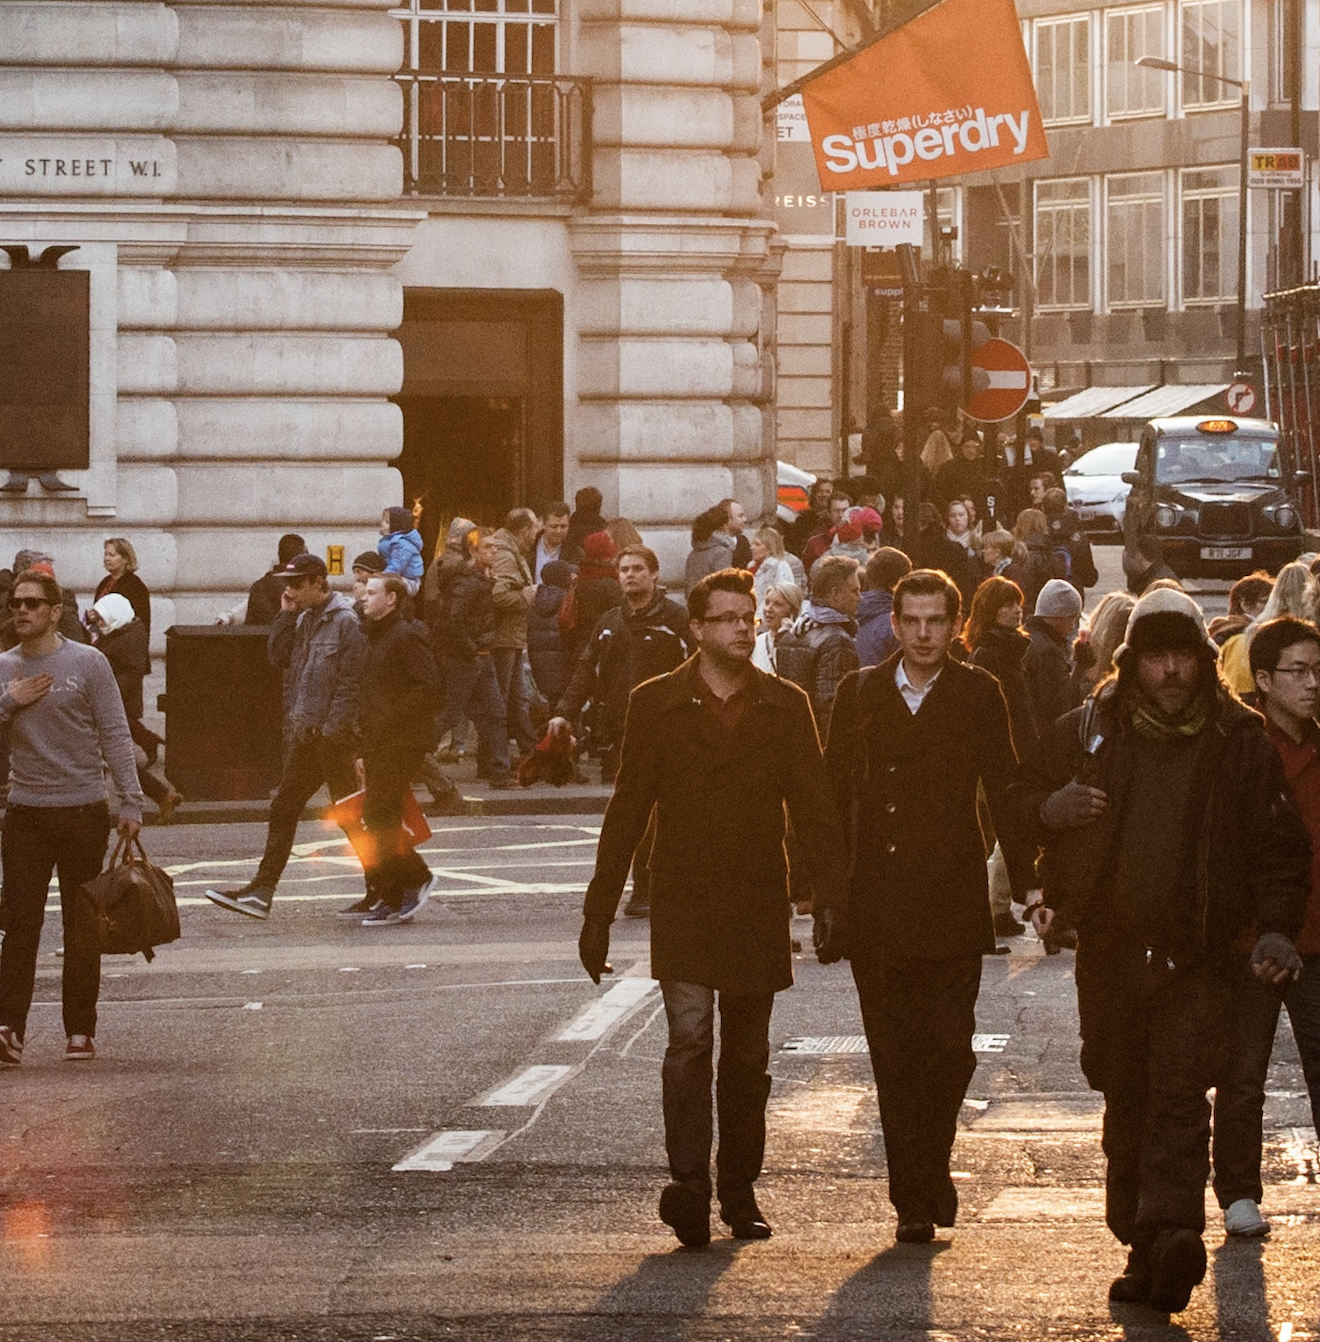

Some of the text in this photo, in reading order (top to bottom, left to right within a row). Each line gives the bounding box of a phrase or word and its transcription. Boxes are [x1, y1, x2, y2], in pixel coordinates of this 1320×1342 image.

[777, 126, 794, 138] ET
[821, 107, 1029, 176] Superdry
[25, 159, 112, 176] STREET
[852, 208, 917, 217] ORLEBAR
[859, 220, 911, 229] BROWN
